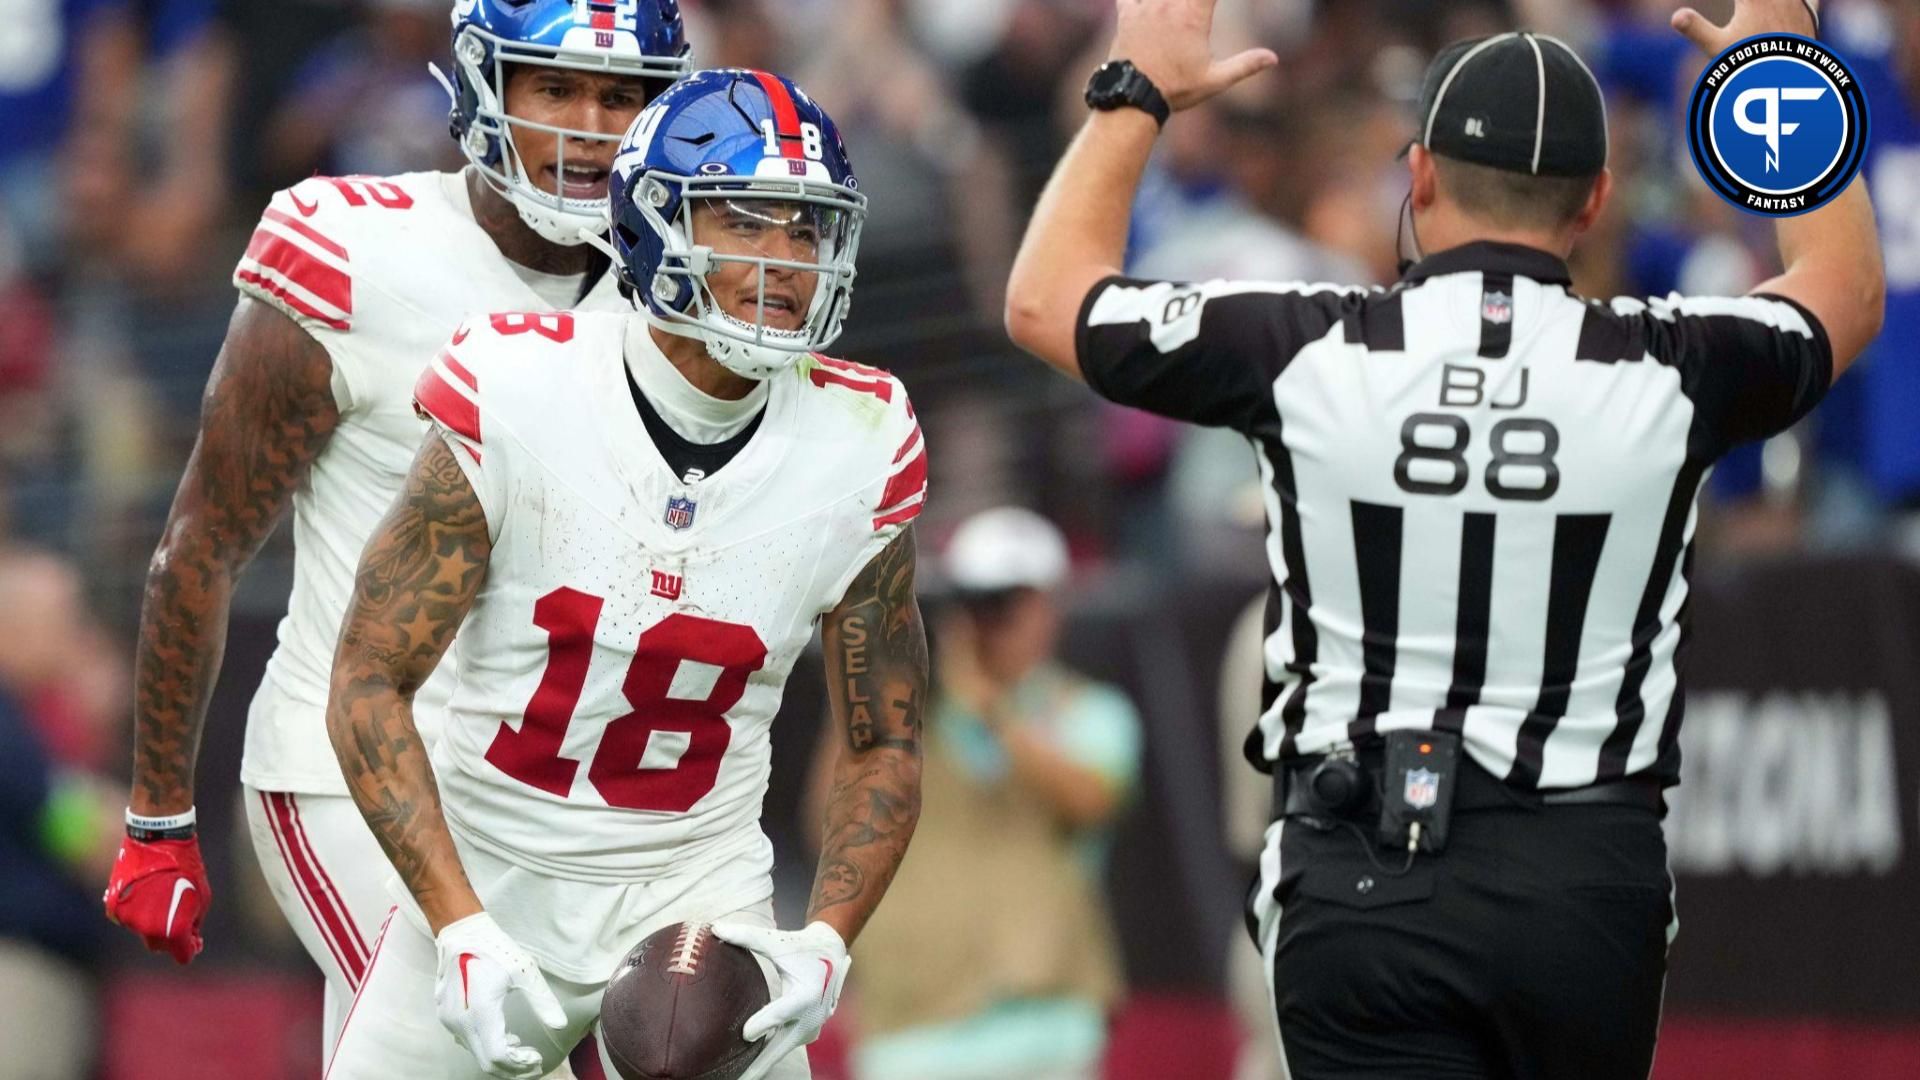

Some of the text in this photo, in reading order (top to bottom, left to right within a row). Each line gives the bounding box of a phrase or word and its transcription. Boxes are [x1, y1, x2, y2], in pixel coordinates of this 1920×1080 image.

[760, 118, 824, 161] 18
[1465, 117, 1485, 138] BL
[1438, 363, 1529, 410] BJ
[1393, 412, 1560, 502] 88
[651, 569, 682, 601] ny
[484, 585, 769, 813] 18
[842, 616, 873, 749] SELAH
